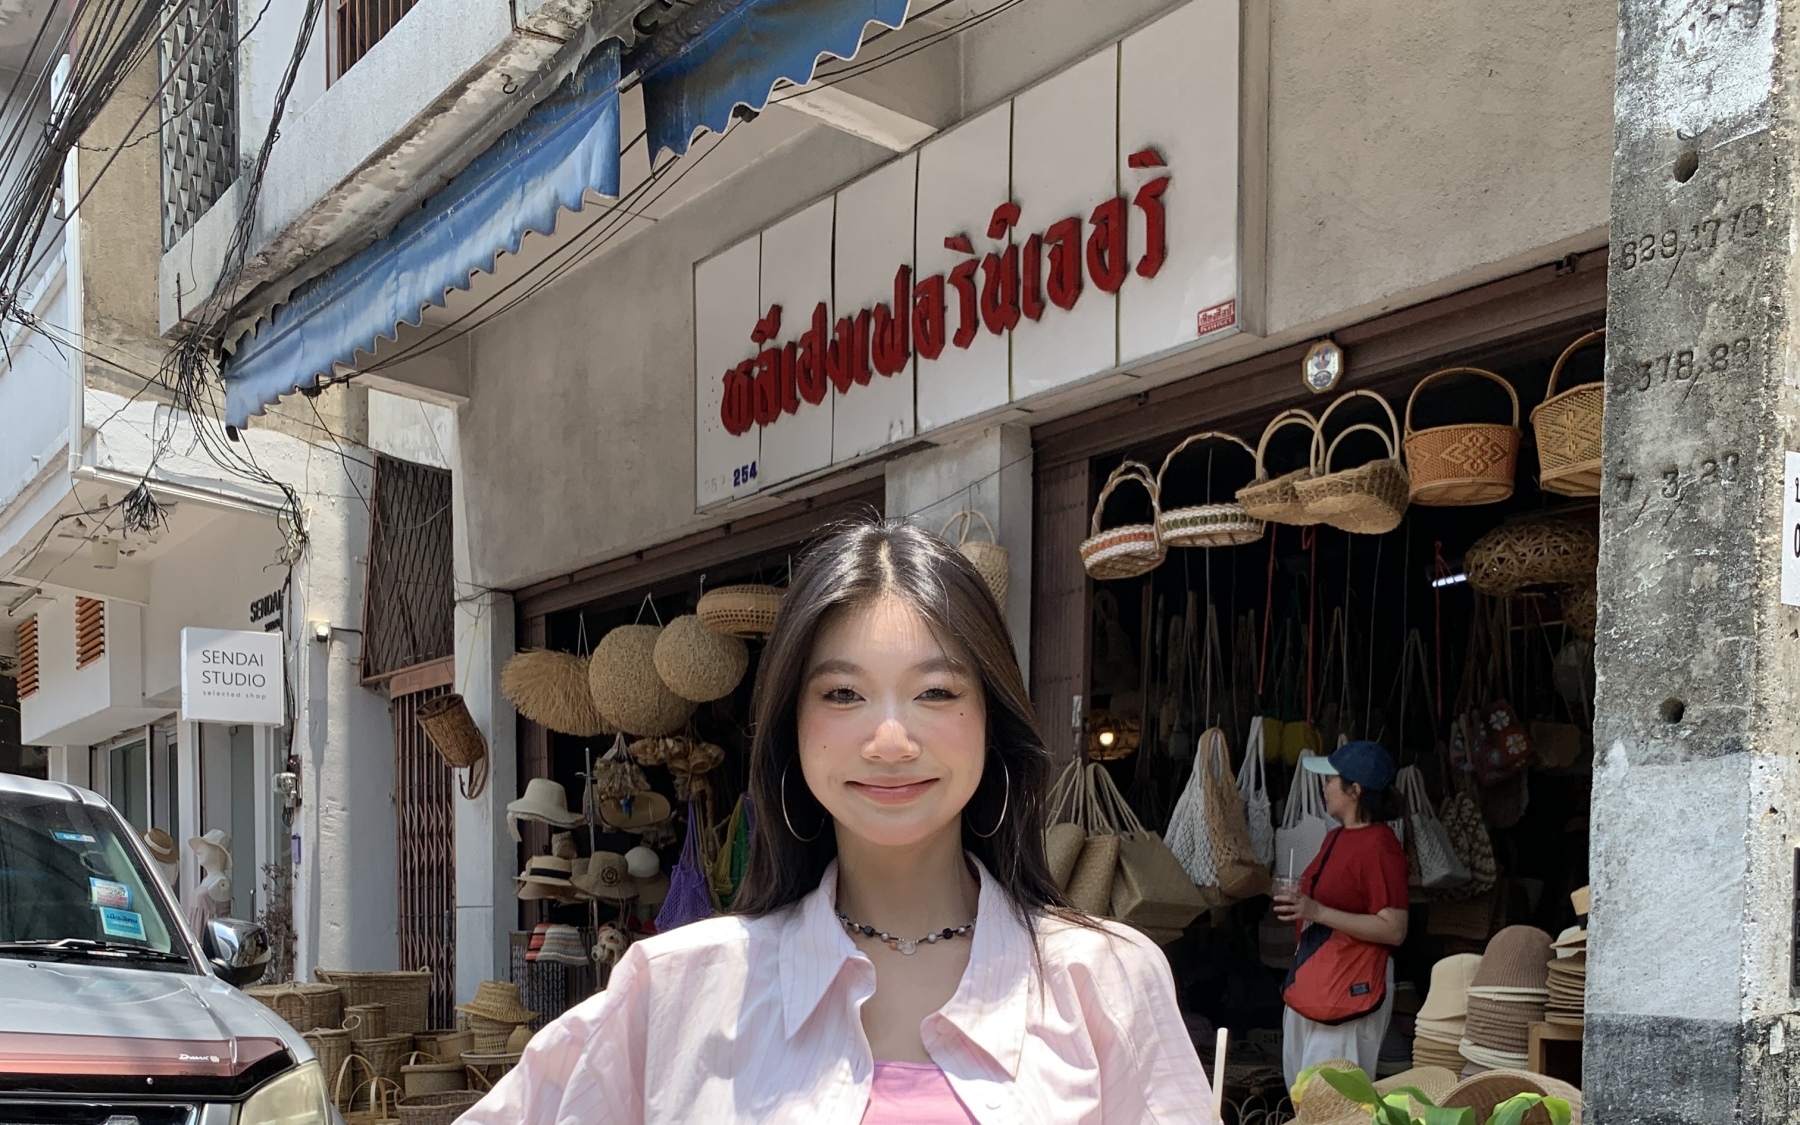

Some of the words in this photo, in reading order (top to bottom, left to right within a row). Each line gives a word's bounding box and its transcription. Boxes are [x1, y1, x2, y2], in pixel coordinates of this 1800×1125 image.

[733, 460, 758, 487] 254
[202, 649, 264, 668] SENDAI
[202, 670, 266, 688] STUDIO
[203, 690, 241, 698] selected
[245, 692, 267, 700] shop
